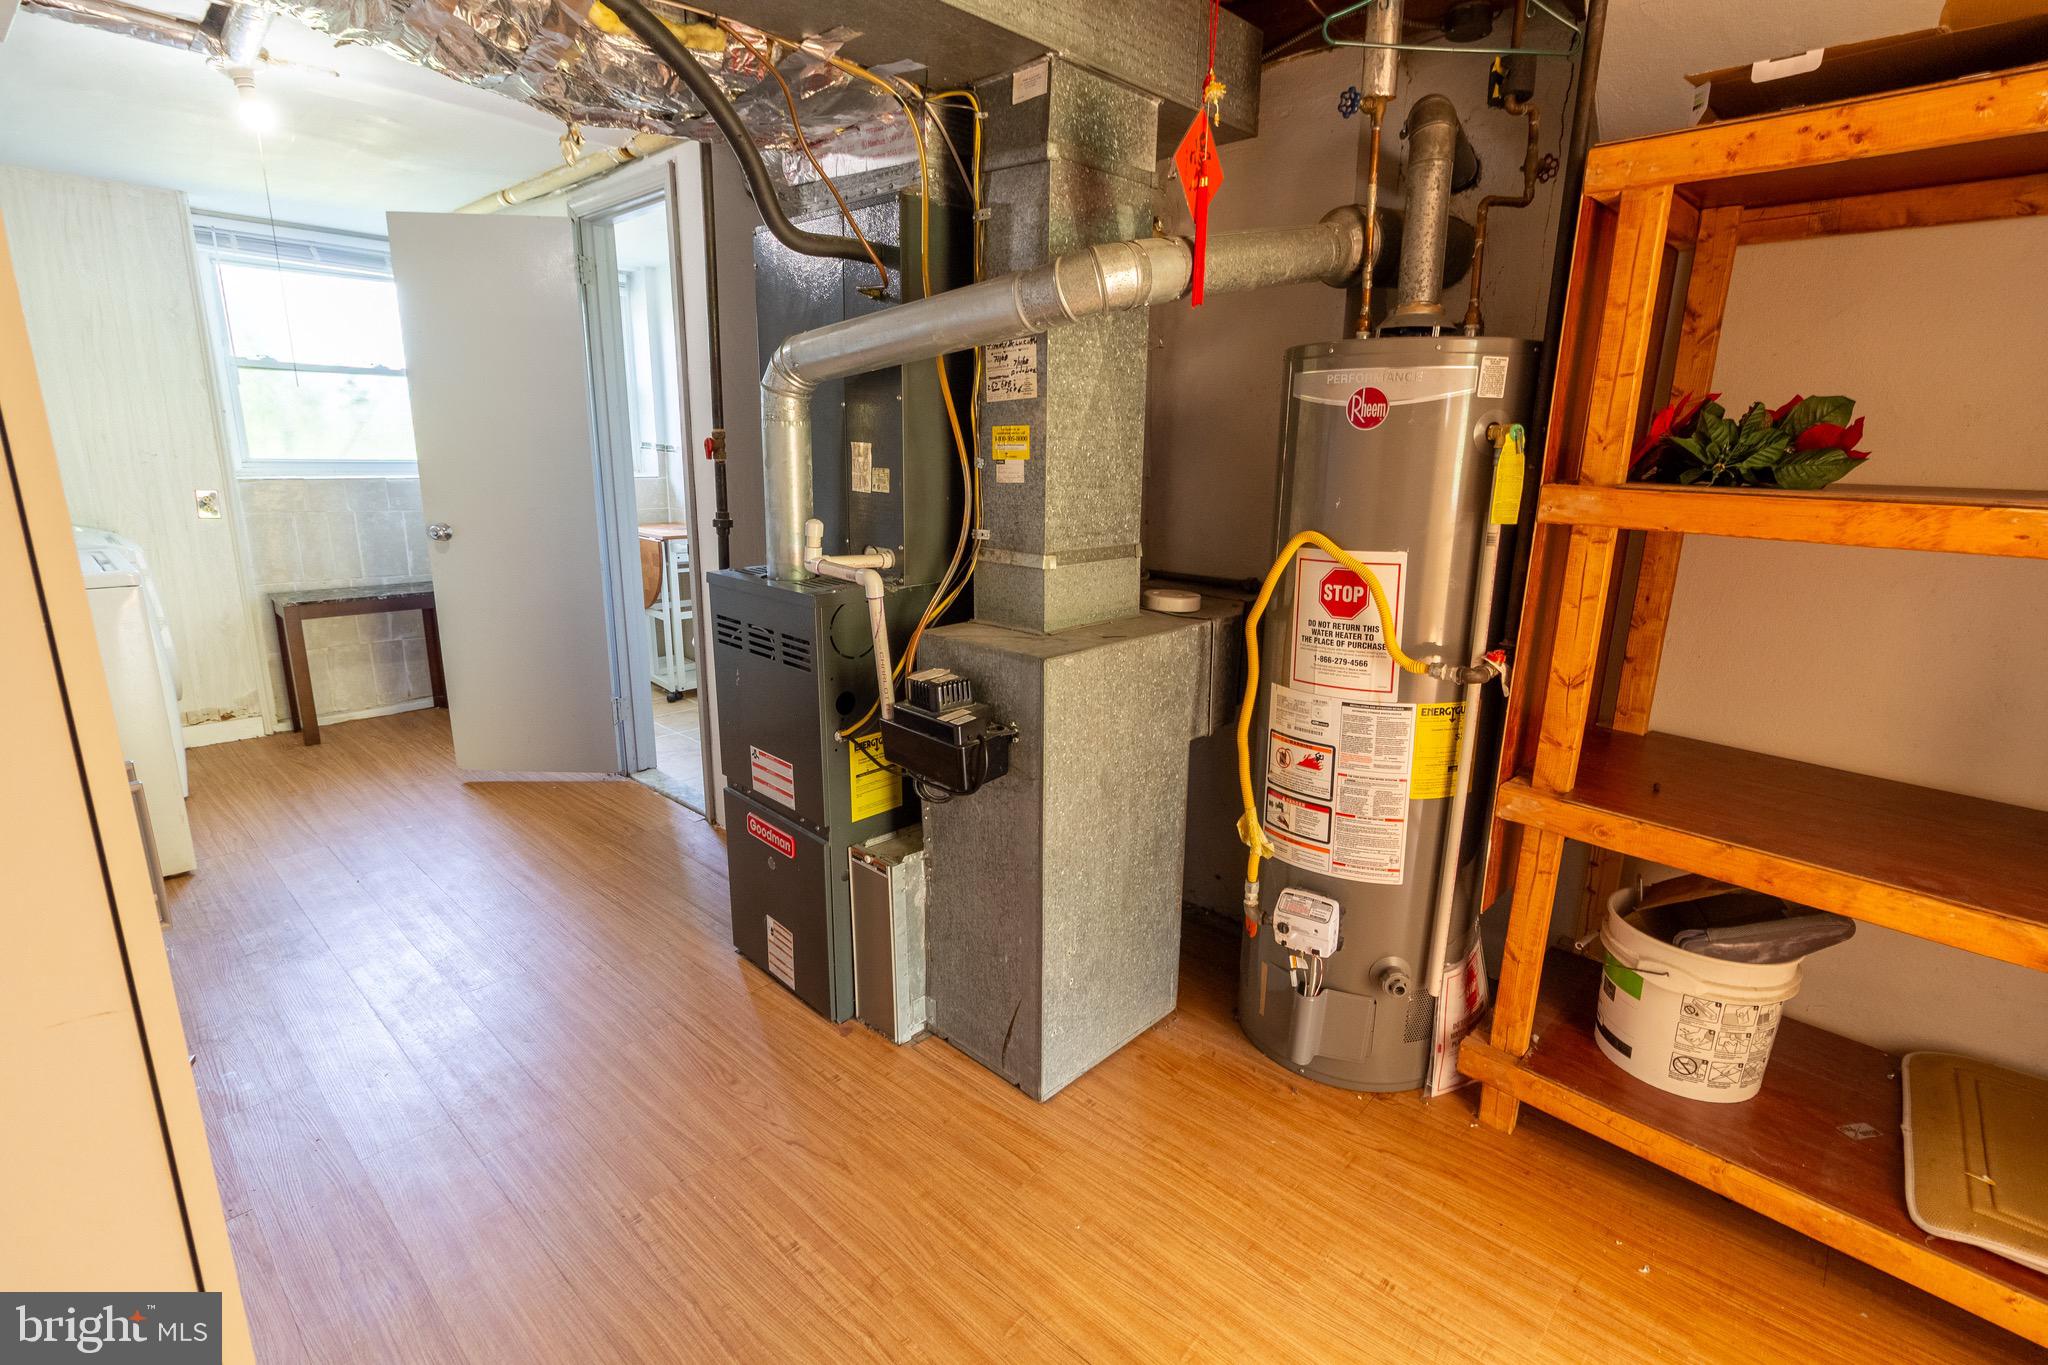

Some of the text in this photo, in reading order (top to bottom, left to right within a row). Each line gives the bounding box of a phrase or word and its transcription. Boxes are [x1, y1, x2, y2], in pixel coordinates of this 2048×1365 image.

[1350, 387, 1387, 423] Rheem
[1323, 583, 1364, 603] STOP
[1308, 619, 1380, 633] DO NOT RETURN THIS
[1311, 628, 1375, 642] WATER HEATER TO
[1301, 635, 1386, 651] THE PLACE OF PURCHASE
[1313, 654, 1369, 668] 1-866-279-4566
[1421, 705, 1466, 720] ENERGYGU
[750, 819, 791, 851] Goodman
